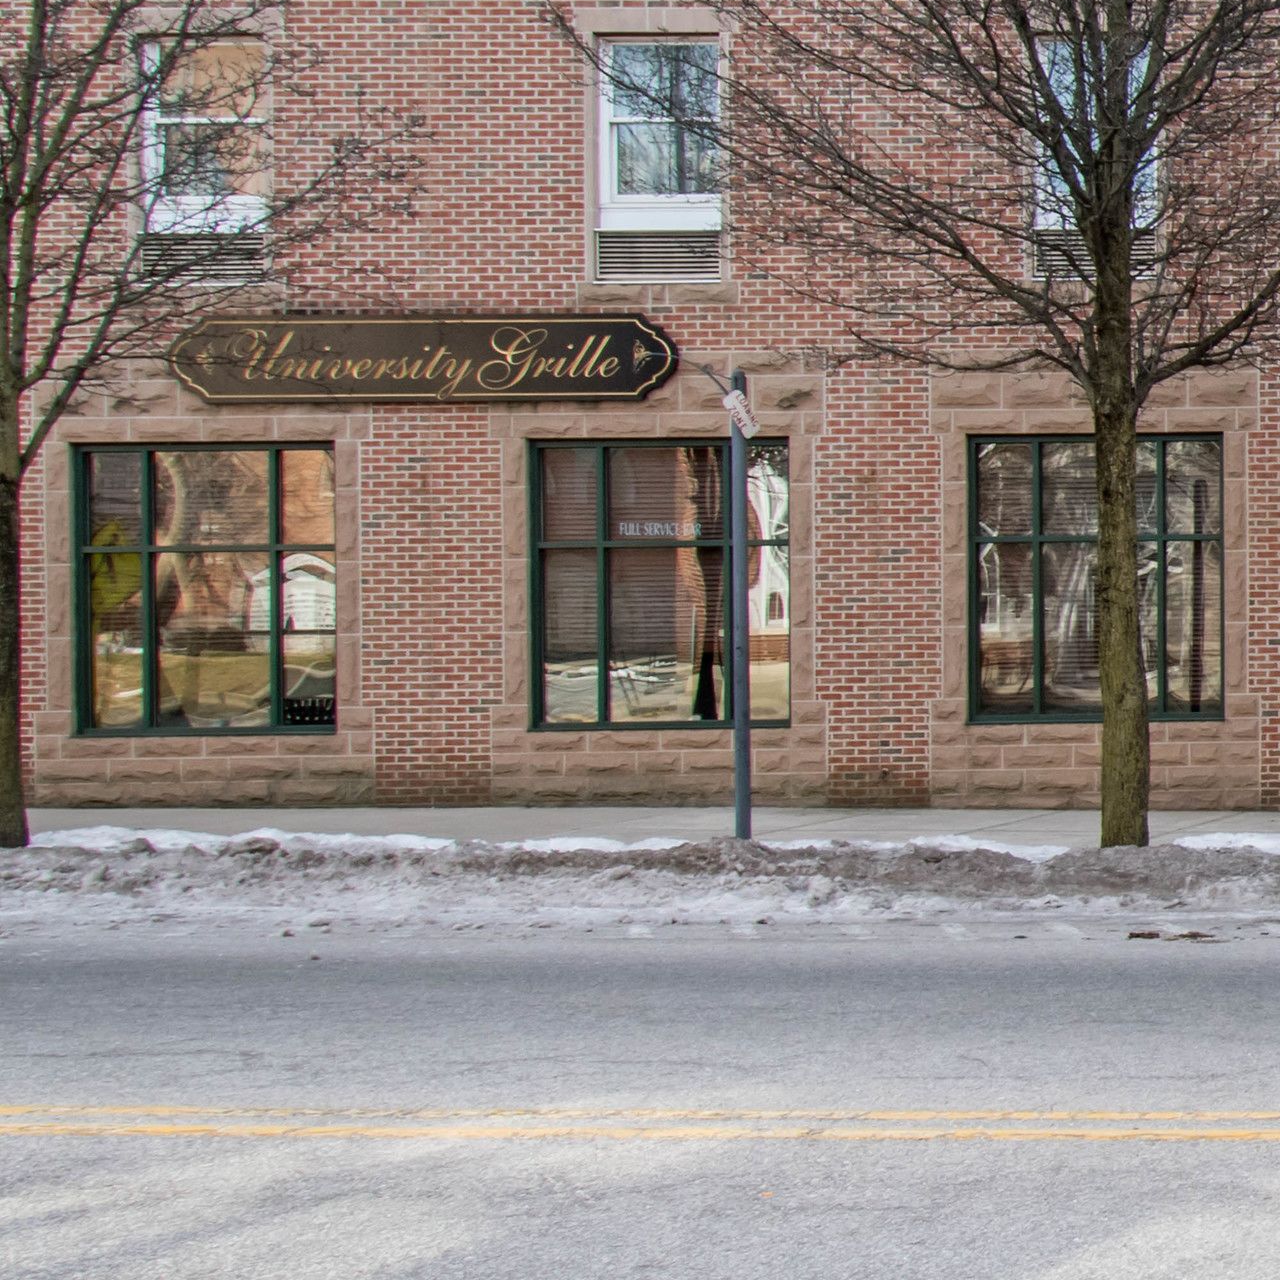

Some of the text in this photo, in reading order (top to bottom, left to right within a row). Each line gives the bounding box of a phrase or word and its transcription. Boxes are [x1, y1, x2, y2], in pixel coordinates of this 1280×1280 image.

[226, 325, 621, 400] University Grille
[620, 522, 641, 536] FULL
[643, 522, 681, 536] SERVICE
